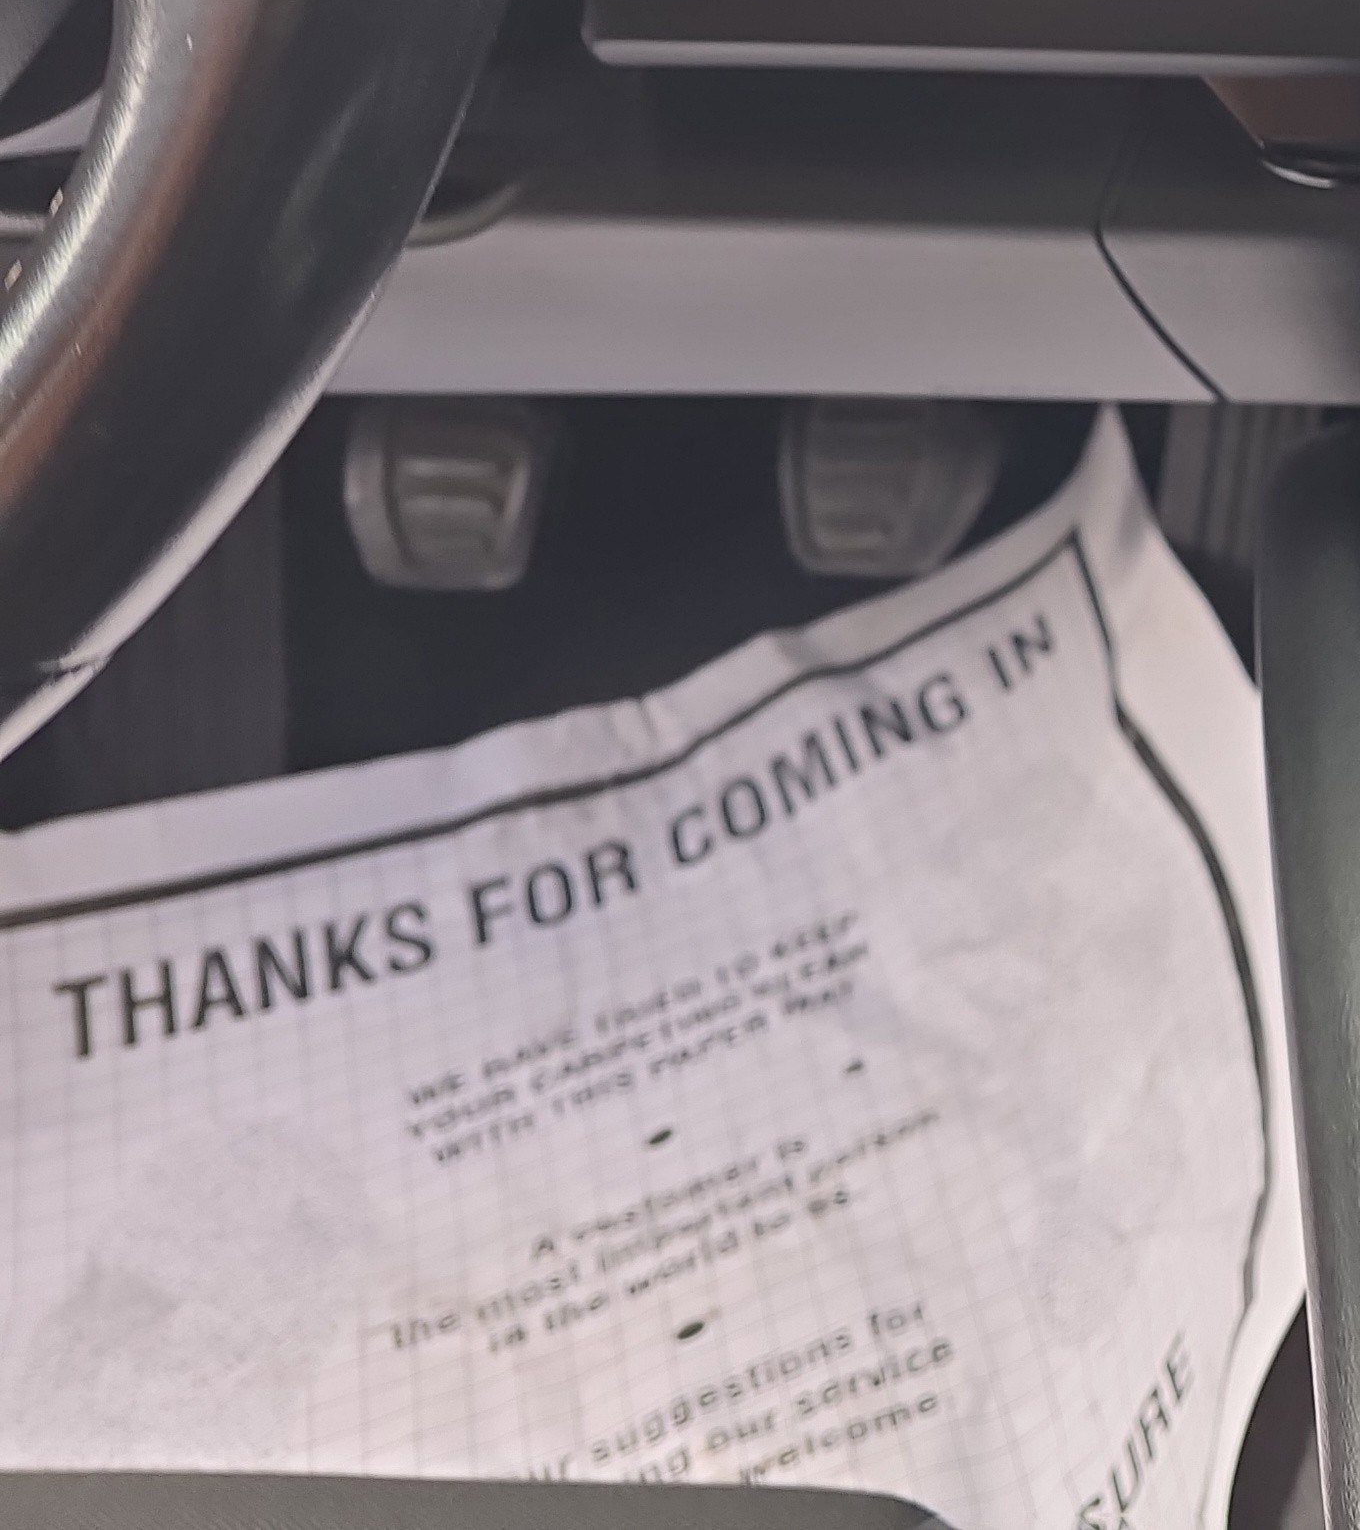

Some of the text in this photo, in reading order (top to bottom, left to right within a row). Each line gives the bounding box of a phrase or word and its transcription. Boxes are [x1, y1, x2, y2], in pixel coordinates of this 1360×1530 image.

[54, 613, 1055, 1061] THANKS FOR COMING IN
[589, 1327, 855, 1464] suggestions
[866, 1299, 925, 1337] for
[704, 1336, 956, 1455] our service
